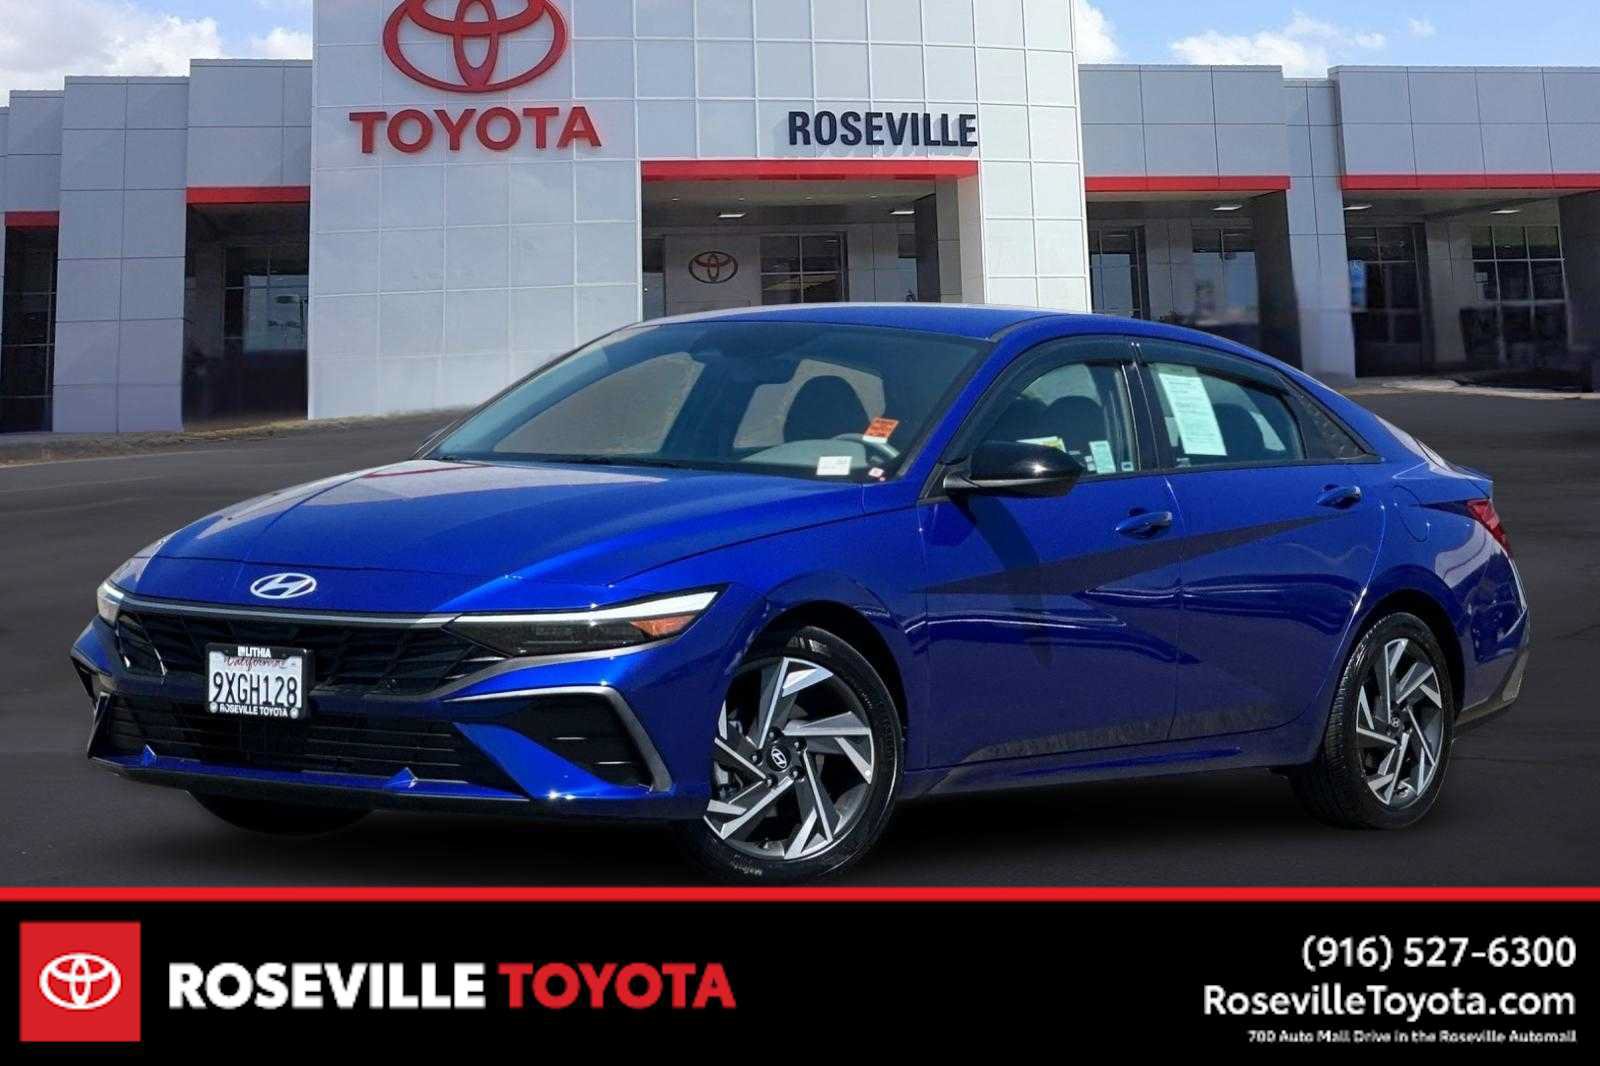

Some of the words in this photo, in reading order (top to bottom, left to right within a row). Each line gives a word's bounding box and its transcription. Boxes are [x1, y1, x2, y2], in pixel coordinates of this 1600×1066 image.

[349, 105, 602, 154] TOYOTA
[788, 110, 978, 148] ROSEVILLE
[245, 647, 271, 657] LITHIA
[213, 671, 297, 707] 9XGH128
[219, 704, 258, 715] ROSEVILLE
[260, 706, 288, 717] TOYOTA
